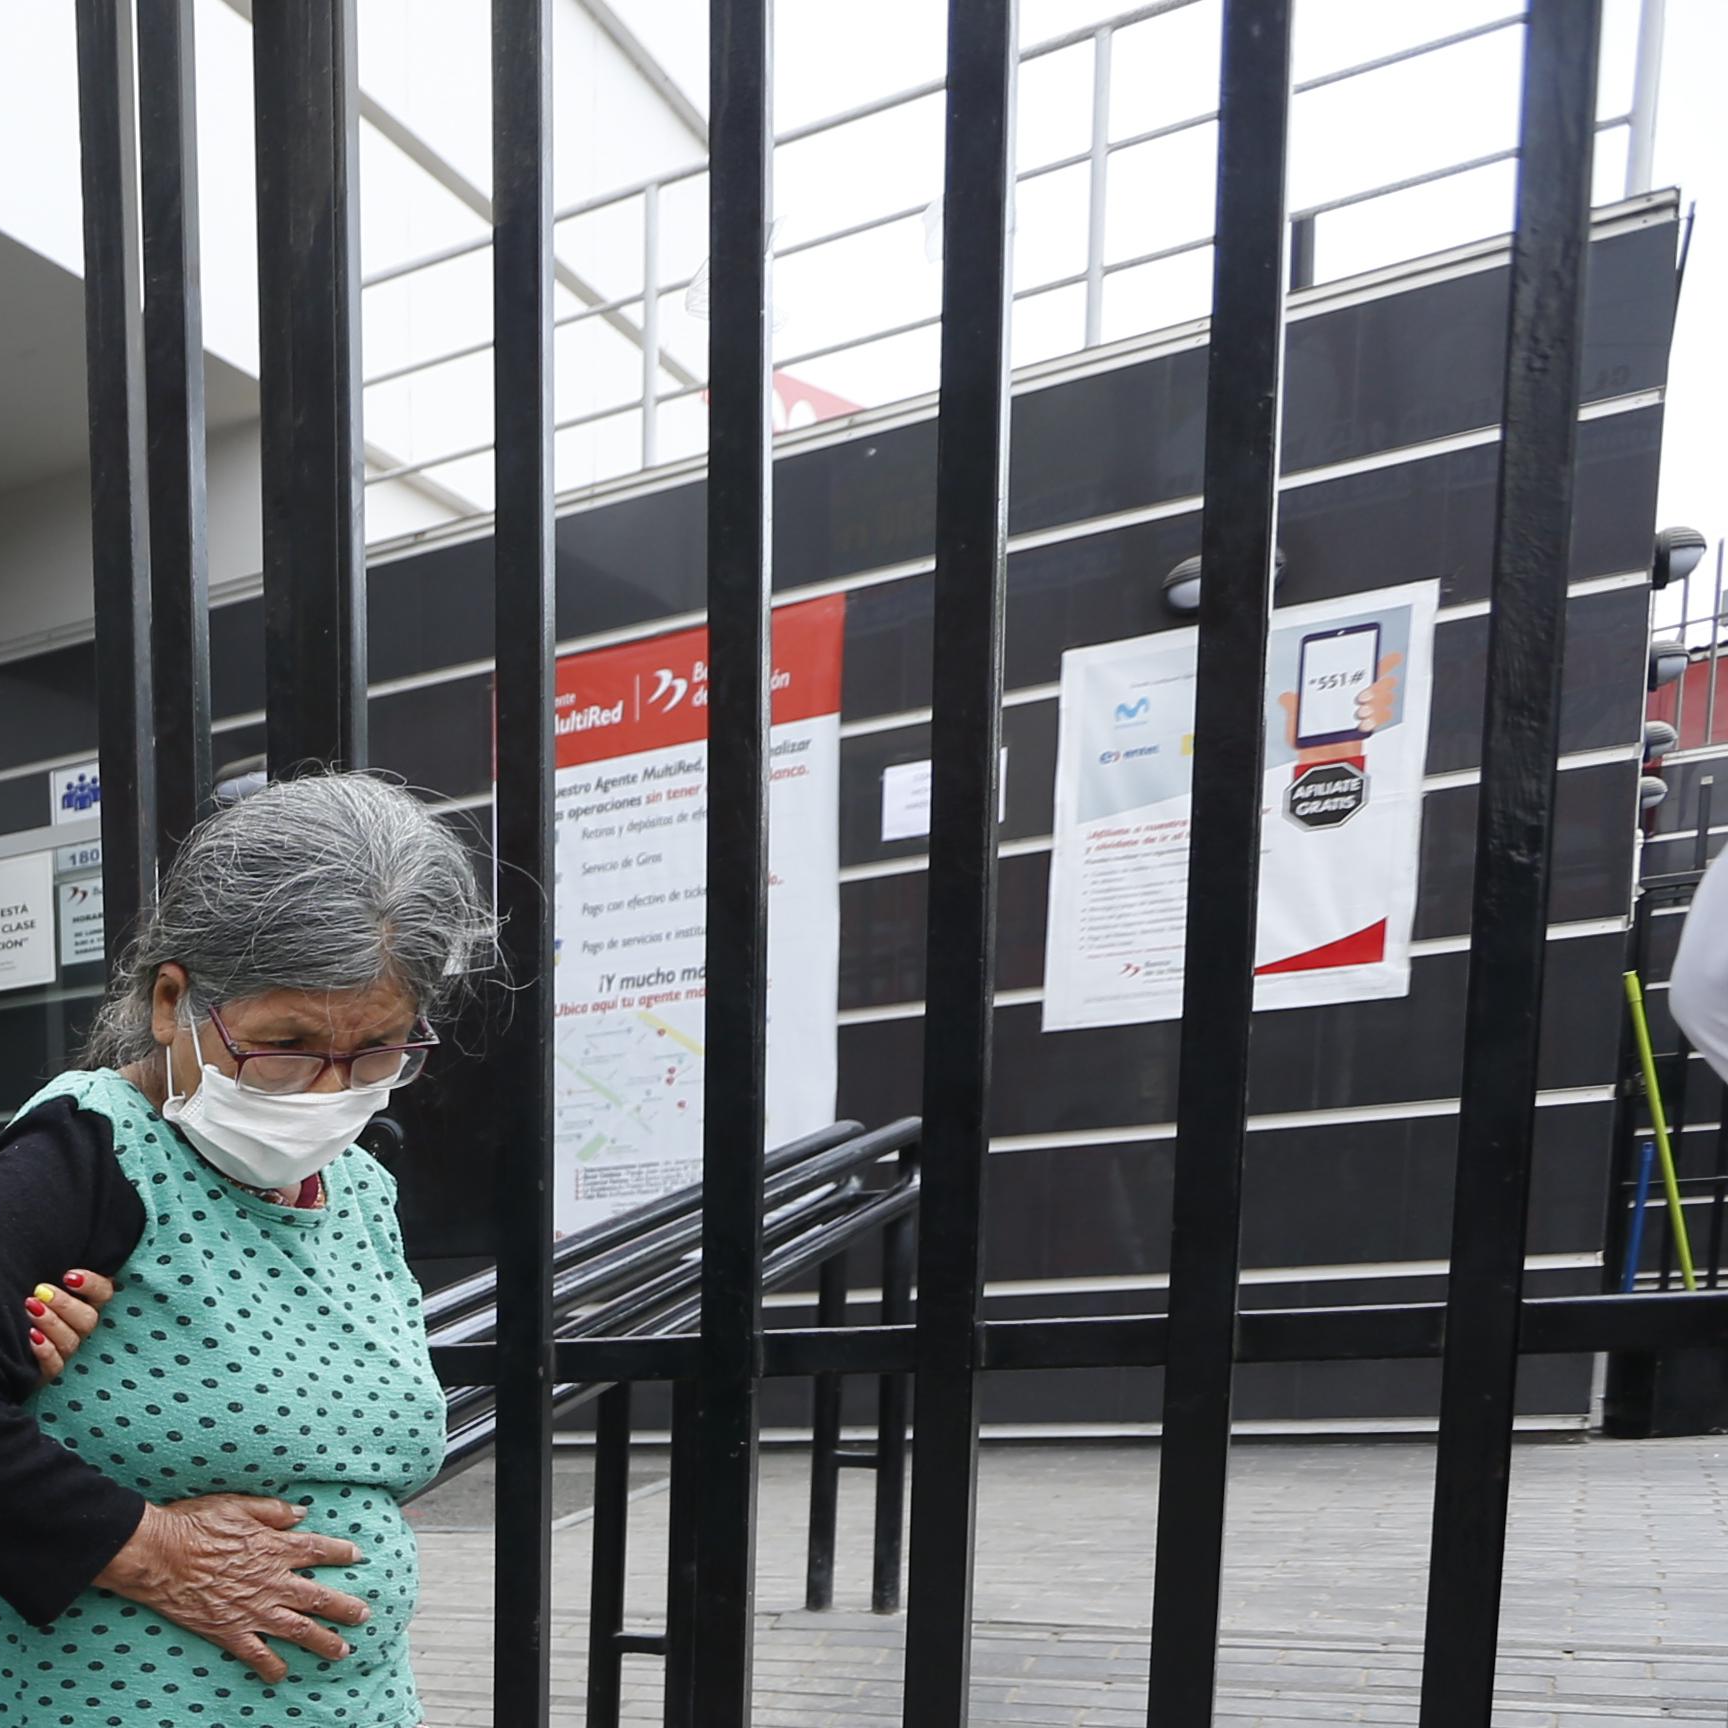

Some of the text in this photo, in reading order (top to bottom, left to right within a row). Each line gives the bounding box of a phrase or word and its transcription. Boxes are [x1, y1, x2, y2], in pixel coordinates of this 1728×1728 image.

[595, 774, 638, 794] Agente
[642, 758, 705, 784] MultiRed,
[568, 796, 642, 822] operaciones
[645, 791, 663, 805] sin
[667, 783, 702, 801] tener
[1296, 794, 1356, 816] GRATIS
[582, 823, 616, 841] Retiros
[677, 812, 689, 824] de
[582, 850, 663, 876] Servicio de Giros
[582, 902, 604, 918] Pago
[607, 898, 624, 913] con
[627, 893, 666, 911] efectivo
[669, 890, 682, 903] de
[1, 919, 36, 934] CLASE
[582, 940, 605, 956] Pago
[607, 937, 619, 950] de
[622, 931, 663, 948] servicios
[620, 966, 676, 990] mucho
[622, 994, 634, 1009] tu
[639, 990, 682, 1009] agente
